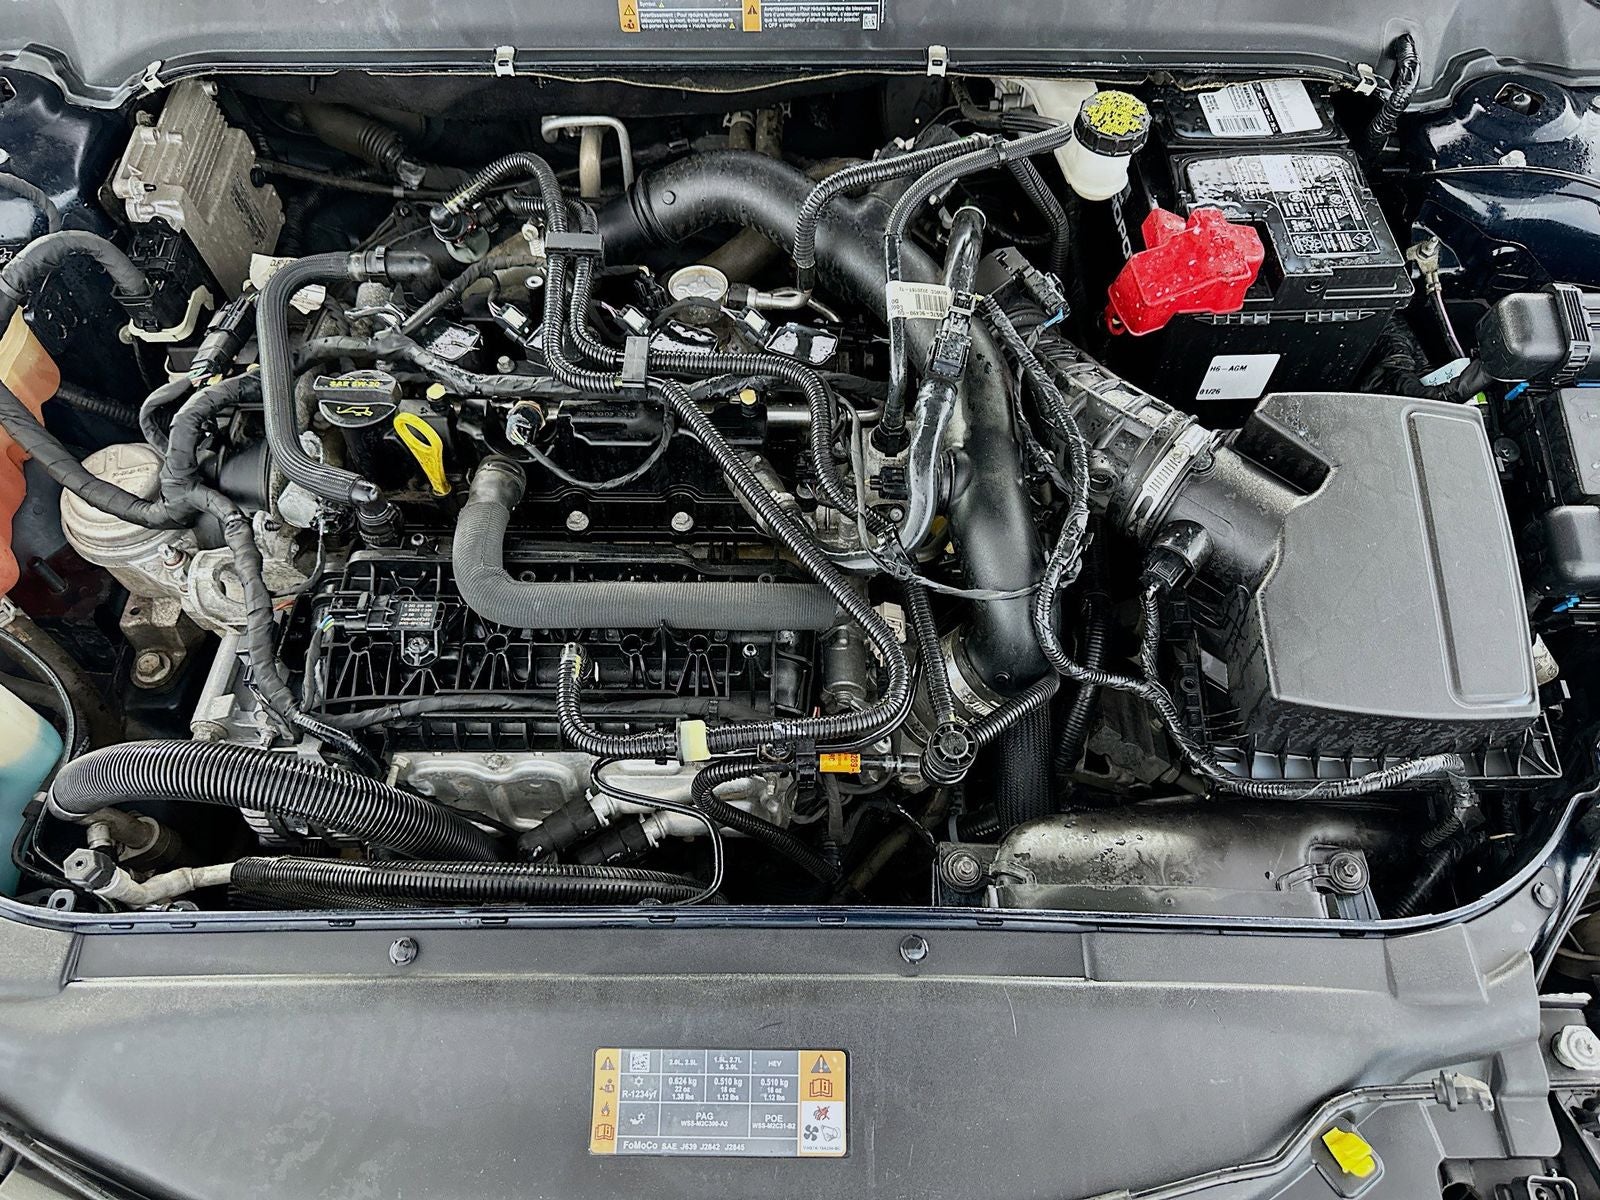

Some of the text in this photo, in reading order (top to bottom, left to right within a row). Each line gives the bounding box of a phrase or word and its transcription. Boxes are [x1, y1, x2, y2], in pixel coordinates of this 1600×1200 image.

[689, 1078, 697, 1087] kg
[734, 1078, 742, 1087] kg
[780, 1079, 788, 1088] kg
[622, 1090, 657, 1100] R-1234yf
[623, 1141, 658, 1150] FoMoCo
